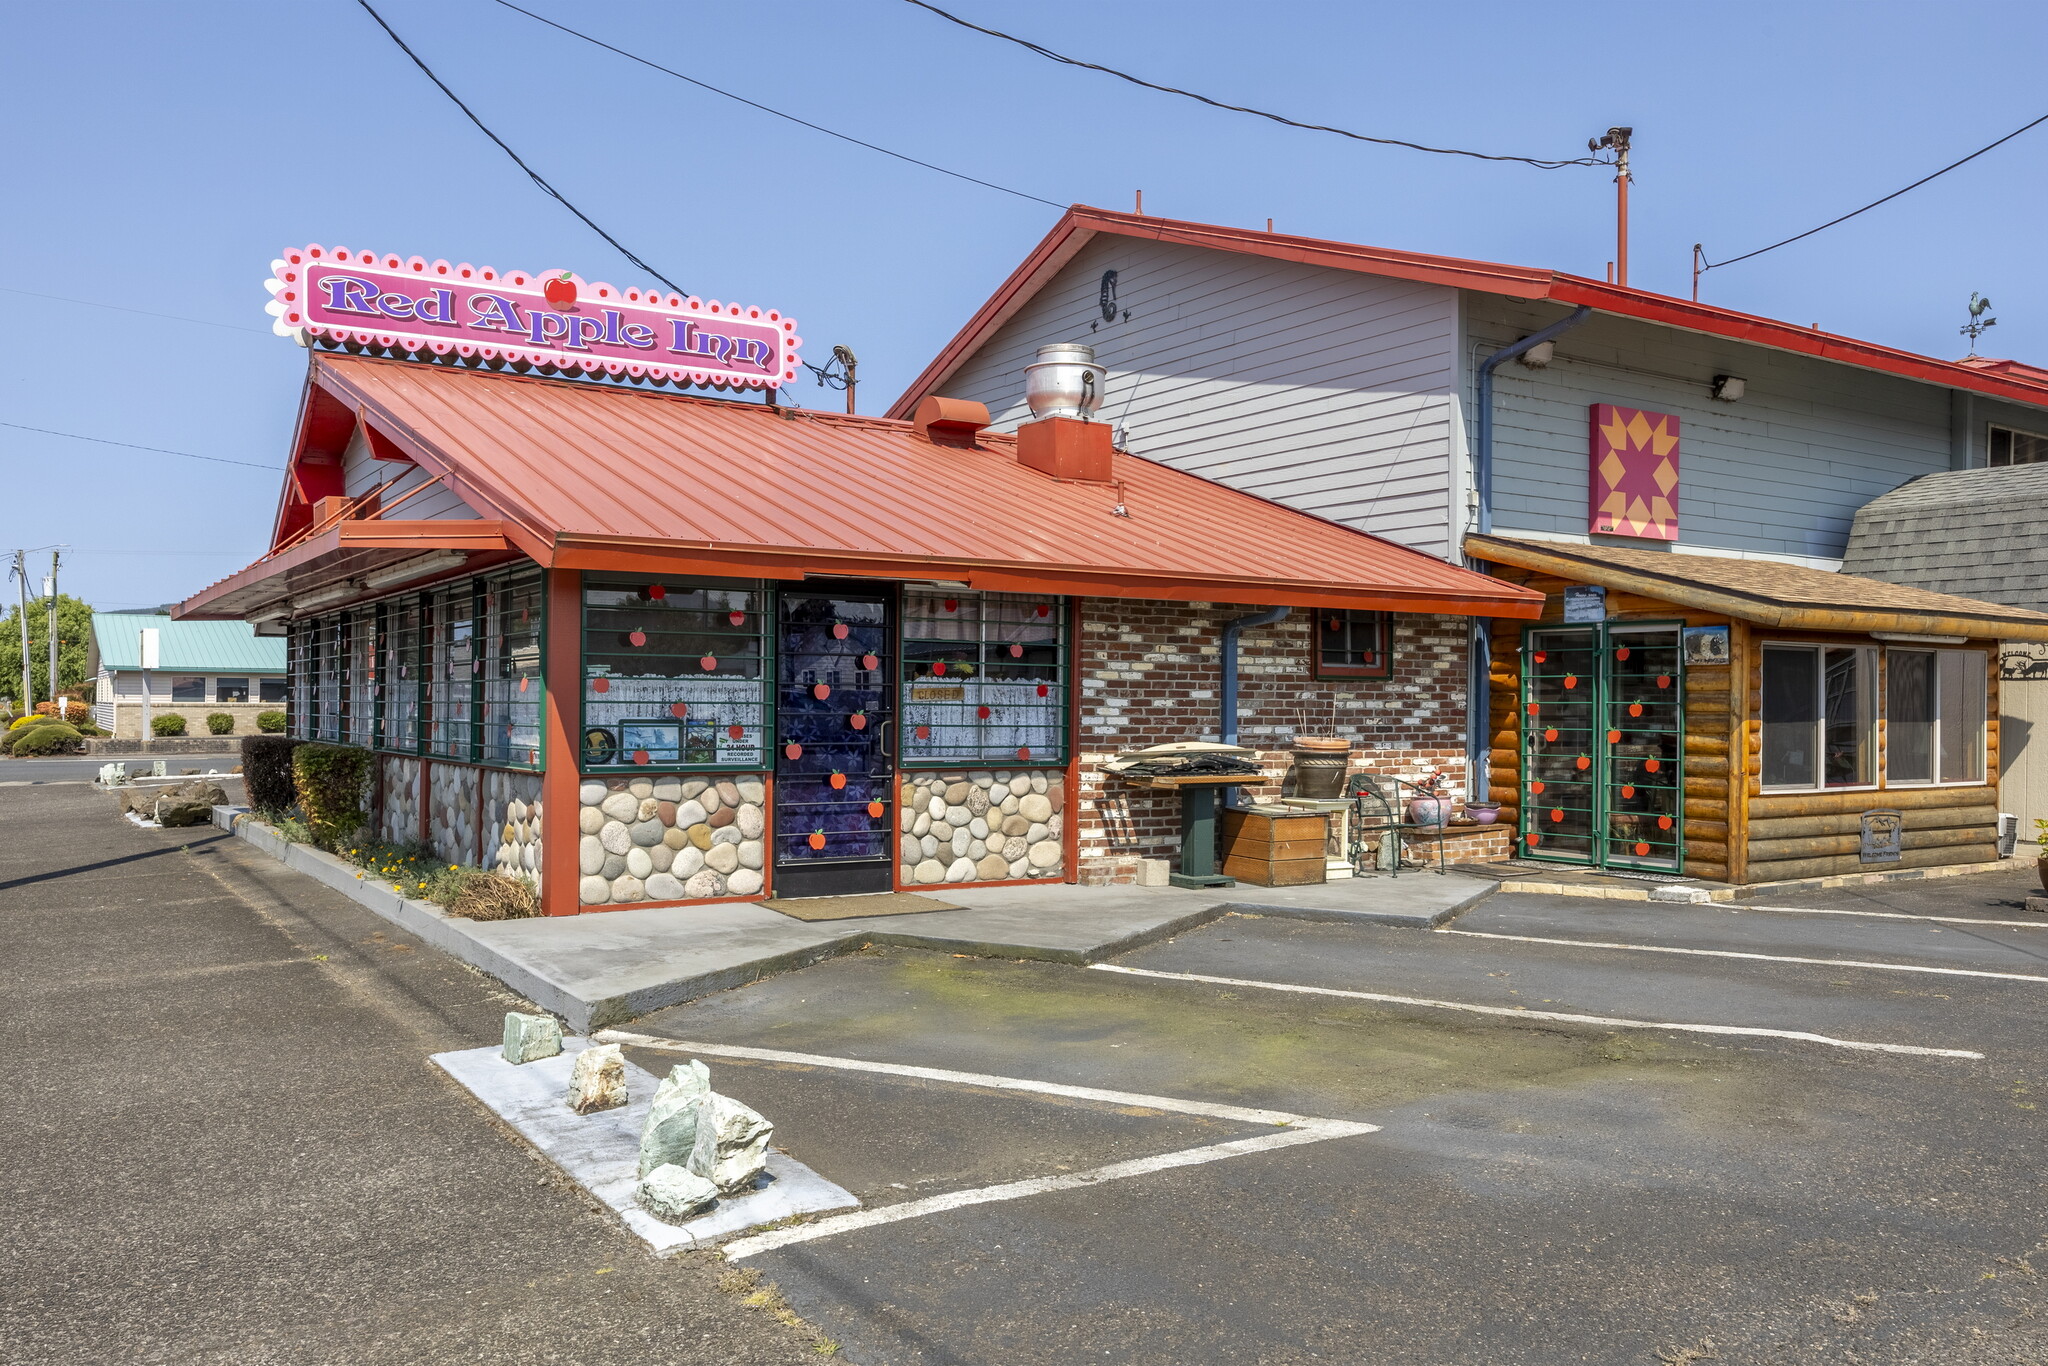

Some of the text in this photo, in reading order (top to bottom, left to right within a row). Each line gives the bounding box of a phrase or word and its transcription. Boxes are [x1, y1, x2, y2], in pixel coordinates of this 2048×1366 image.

[318, 275, 770, 369] Red Apple Inn
[918, 690, 959, 700] CLOSED
